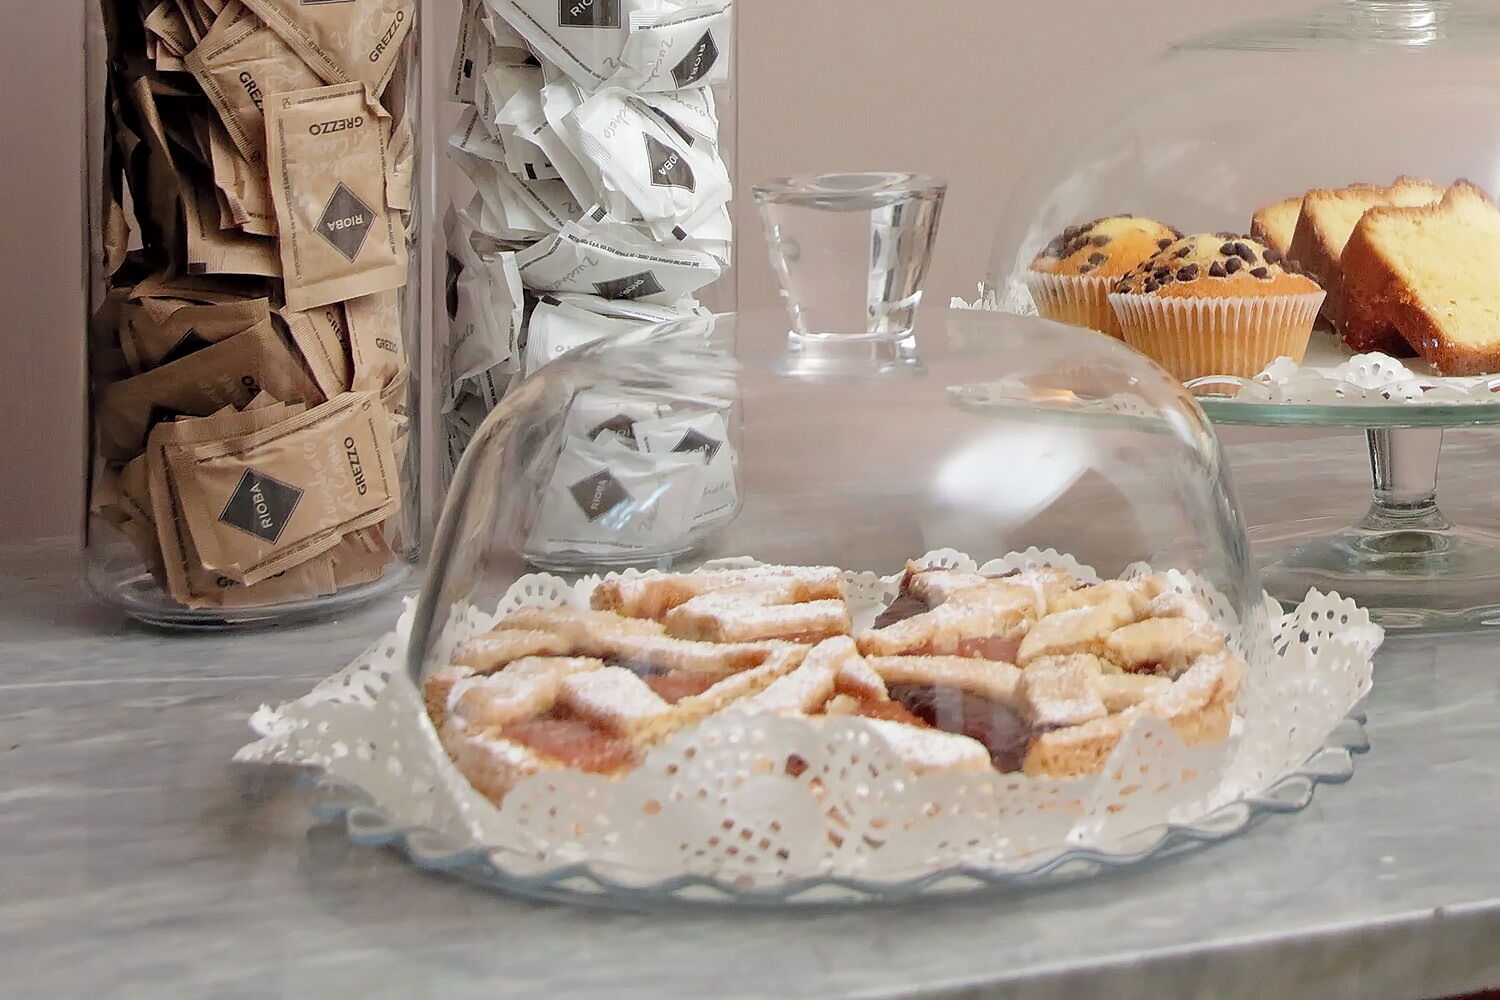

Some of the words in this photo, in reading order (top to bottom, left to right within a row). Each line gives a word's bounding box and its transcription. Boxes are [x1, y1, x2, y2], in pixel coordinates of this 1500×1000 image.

[368, 9, 405, 63] GREZZO
[239, 71, 264, 115] GREZ
[308, 115, 364, 136] GREZZO
[326, 214, 364, 232] RIOBA
[343, 436, 367, 496] GREZZO
[250, 482, 274, 530] RIOBA
[590, 479, 608, 511] RIOBA
